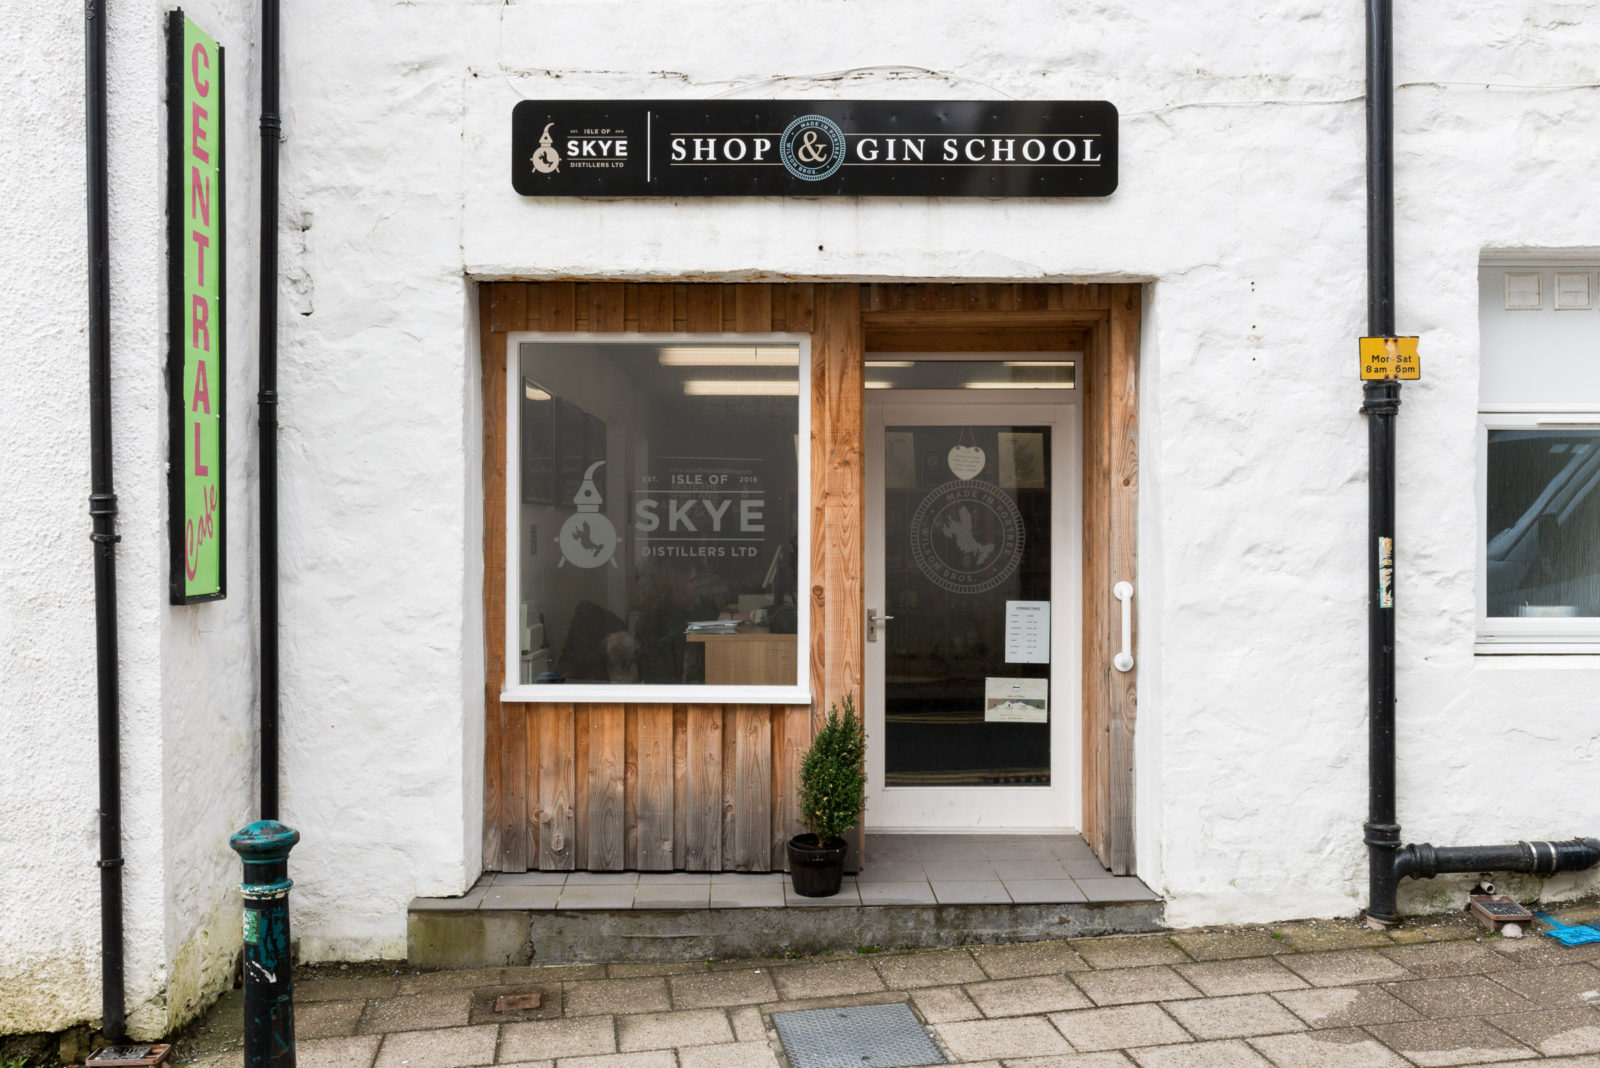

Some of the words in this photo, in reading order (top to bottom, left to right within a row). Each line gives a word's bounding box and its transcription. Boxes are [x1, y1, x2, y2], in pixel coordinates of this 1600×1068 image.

[567, 140, 628, 157] SKYE
[671, 138, 772, 161] SHOP
[798, 131, 827, 162] &
[856, 138, 925, 161] GIN
[943, 138, 1101, 162] SCHOOL
[786, 142, 798, 168] WILSON
[829, 130, 840, 159] PORTREE
[191, 42, 211, 478] CENTRAL
[1395, 364, 1415, 375] 6pm
[1396, 355, 1412, 363] Sat
[671, 474, 703, 485] ISLE
[708, 474, 728, 485] OF
[634, 499, 765, 532] SKYE
[946, 490, 978, 501] MADE
[982, 494, 995, 505] IN
[996, 504, 1015, 556] PORTREE
[642, 546, 726, 558] DISTILLERS
[731, 546, 758, 558] LTD
[921, 527, 943, 570] WILSON
